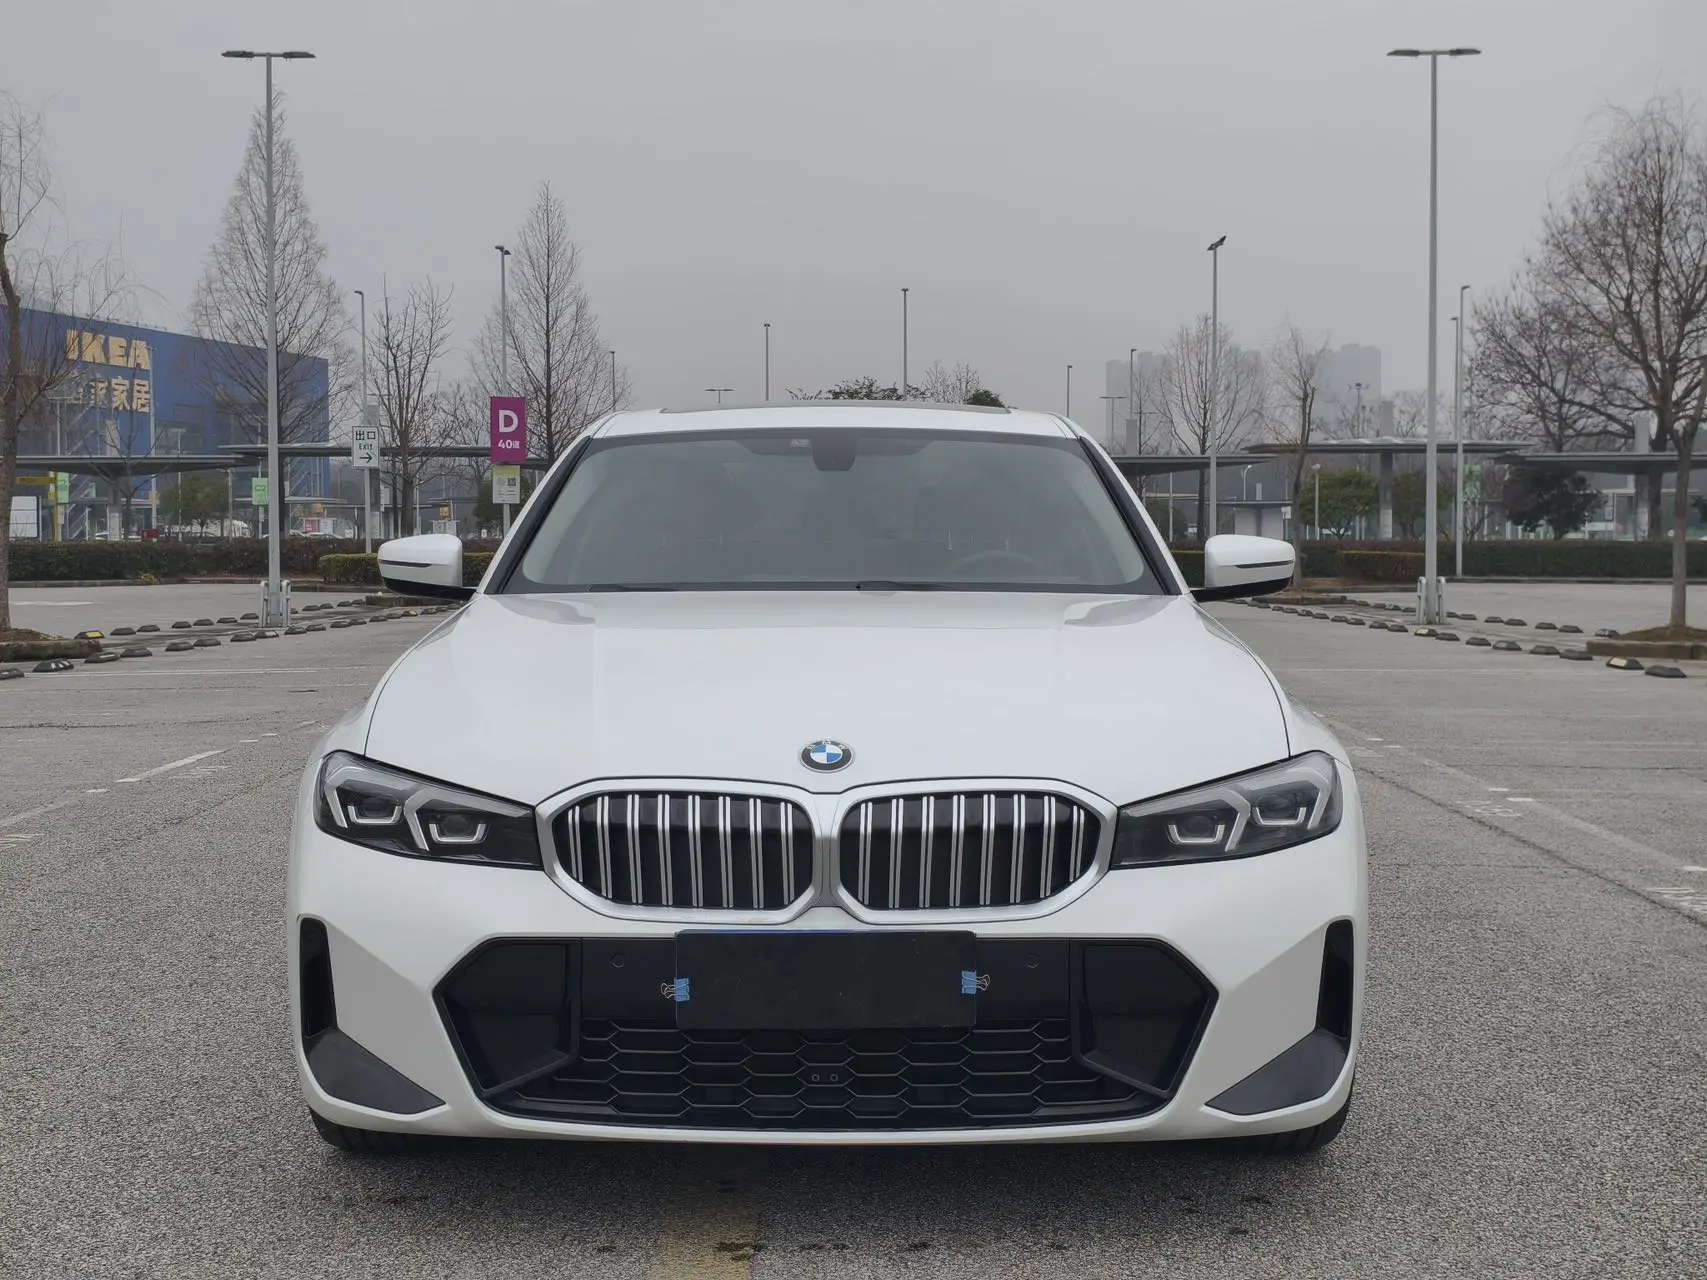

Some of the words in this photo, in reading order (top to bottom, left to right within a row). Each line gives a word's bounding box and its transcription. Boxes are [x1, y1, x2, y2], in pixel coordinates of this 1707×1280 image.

[66, 328, 150, 370] IKEA
[498, 409, 519, 433] D
[355, 430, 376, 441] 出口
[358, 442, 373, 450] Exit
